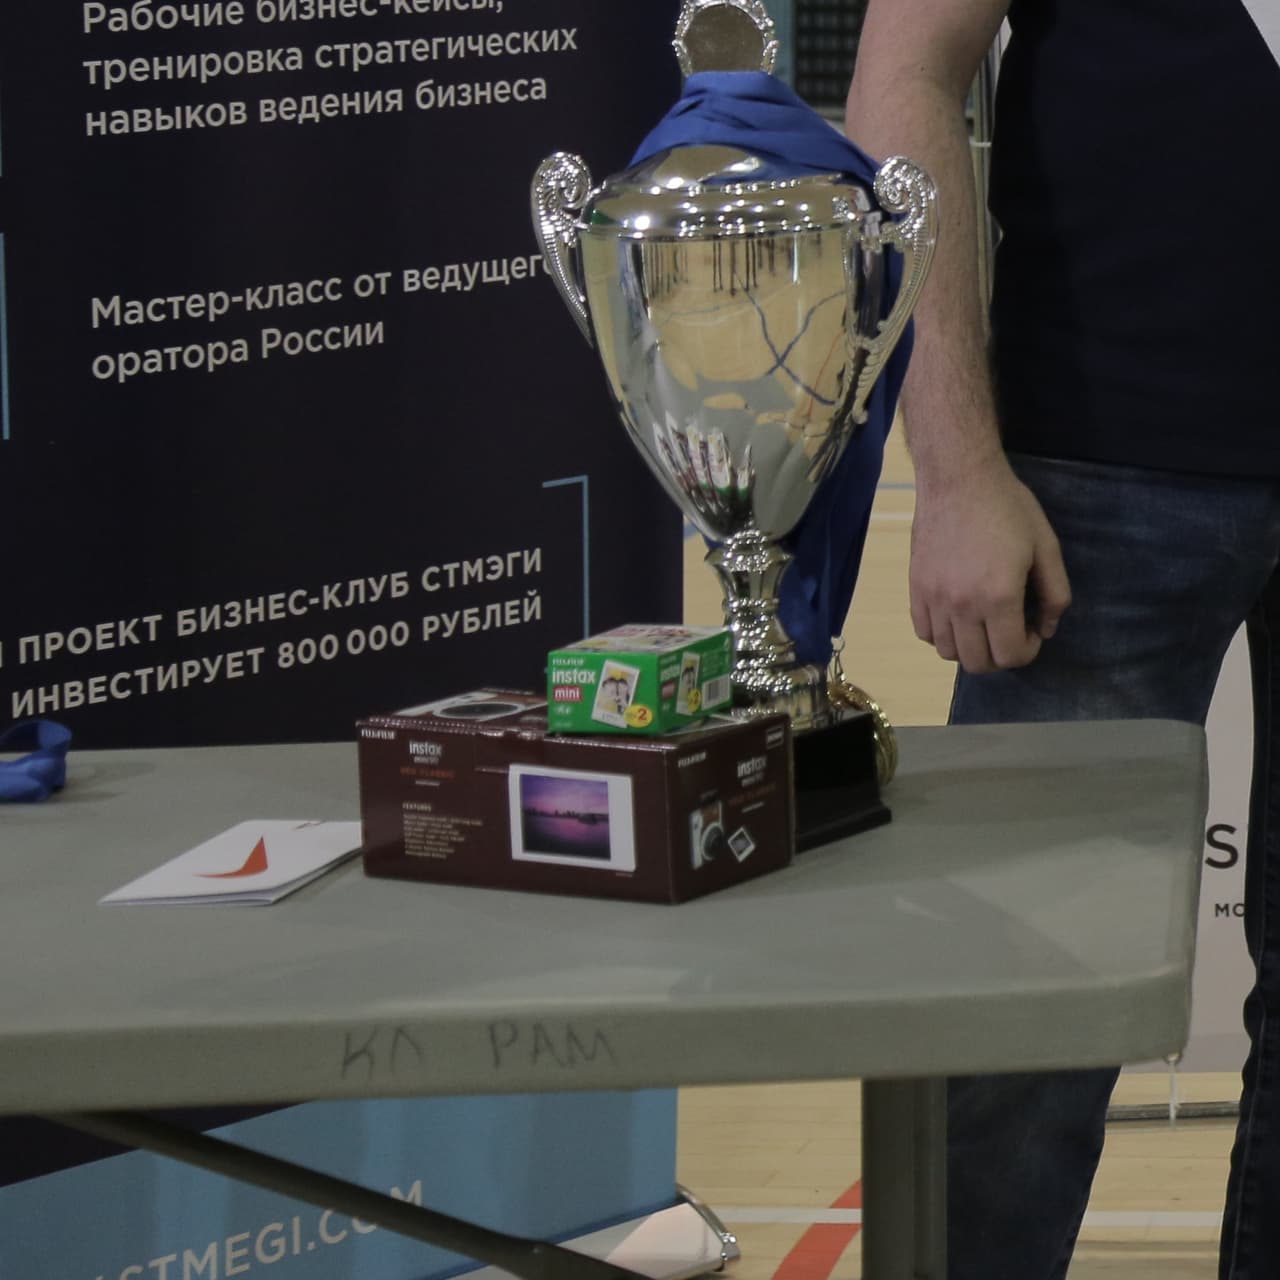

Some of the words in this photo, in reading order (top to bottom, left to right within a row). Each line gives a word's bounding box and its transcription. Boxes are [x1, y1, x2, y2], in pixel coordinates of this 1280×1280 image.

[83, 45, 304, 90] тренировка
[315, 26, 578, 71] стратегических
[86, 97, 248, 136] навыков
[259, 87, 403, 125] ведения
[415, 76, 548, 111] бизнеса
[92, 279, 343, 328] Мастер-класс
[353, 271, 392, 298] от
[92, 334, 250, 382] оратора
[261, 319, 385, 359] России
[18, 615, 164, 665] ПРОЕКТ
[175, 570, 411, 637] БИЗНЕС-КЛУБ
[421, 547, 544, 596] СТМЭГИ
[11, 649, 263, 719] ИНВЕСТИРУЕТ
[276, 634, 339, 672] 800
[347, 623, 410, 661] 000
[421, 589, 544, 641] РУБЛЕЙ
[552, 668, 596, 684] instax
[555, 688, 580, 699] mini
[409, 741, 442, 756] instax
